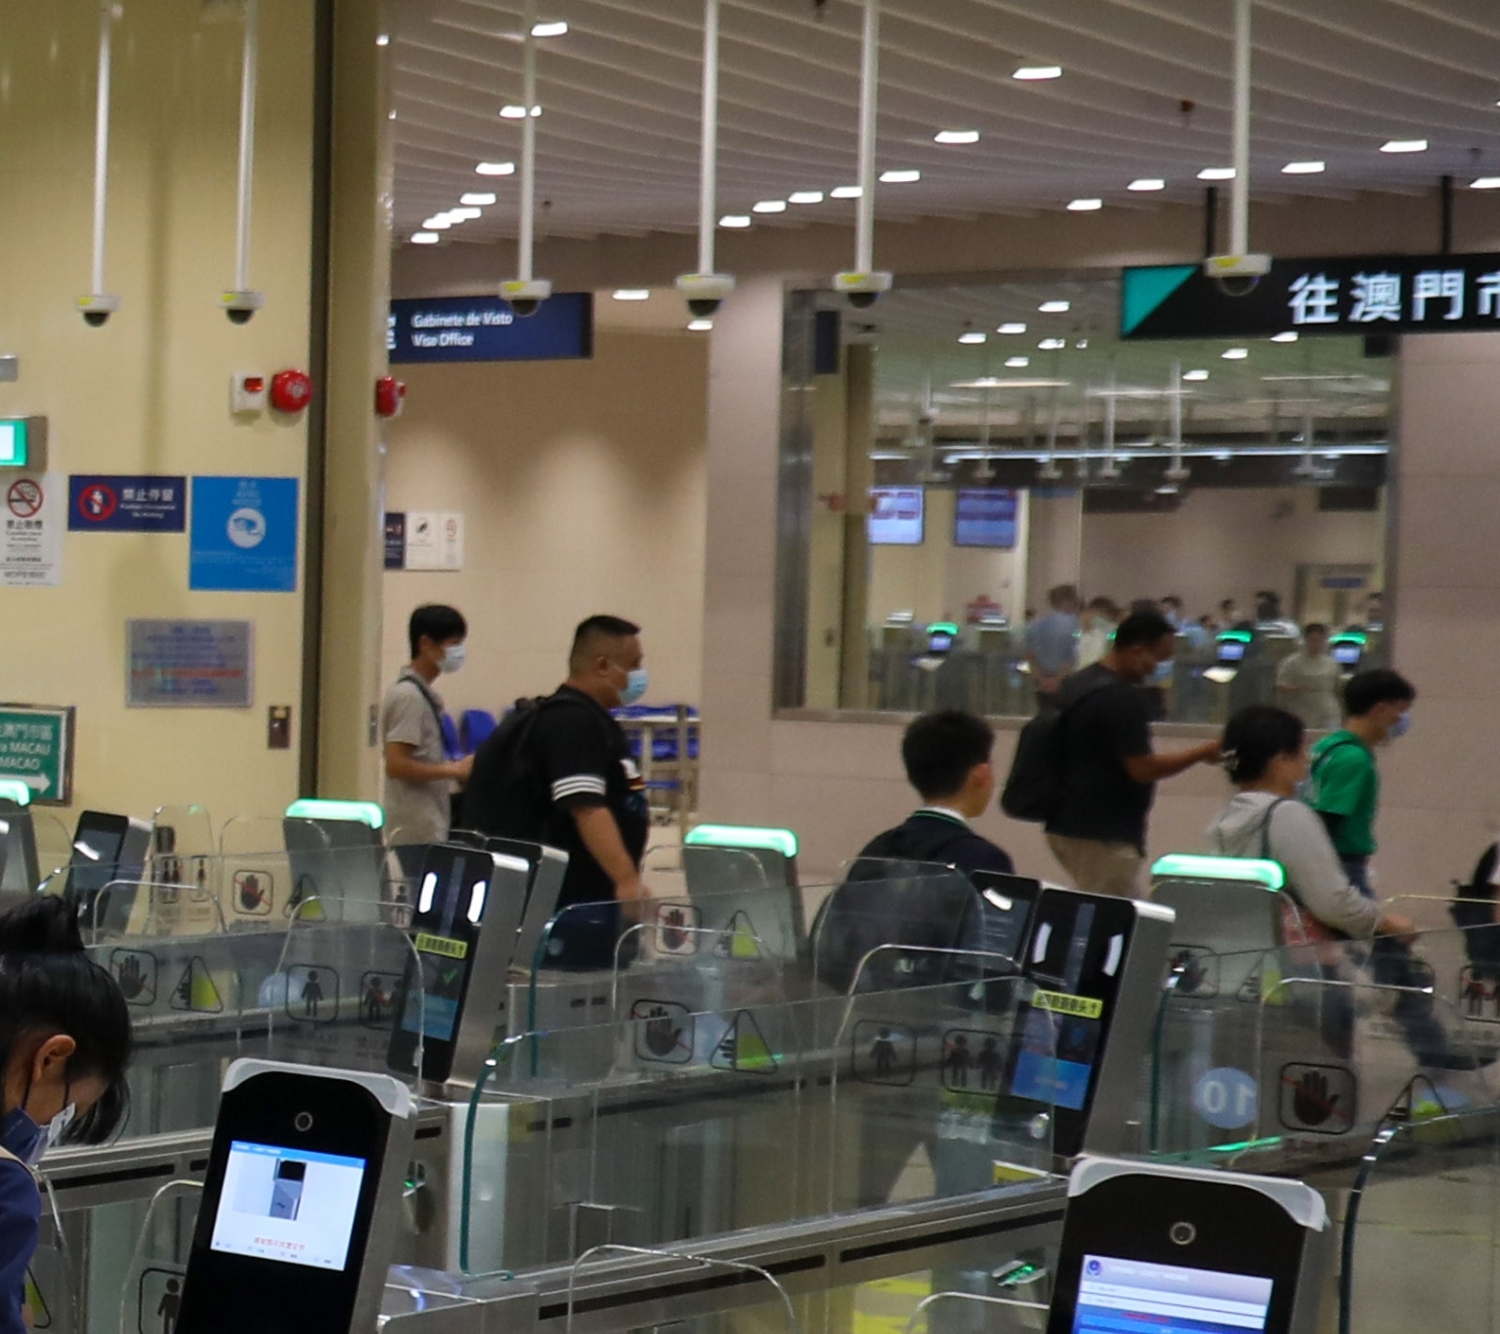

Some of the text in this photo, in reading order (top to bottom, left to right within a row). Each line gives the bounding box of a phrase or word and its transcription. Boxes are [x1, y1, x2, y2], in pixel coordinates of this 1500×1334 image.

[411, 313, 464, 328] Gabinete
[466, 312, 481, 326] de
[439, 333, 474, 346] Office
[9, 741, 50, 755] MACAU
[0, 757, 40, 769] MACAO
